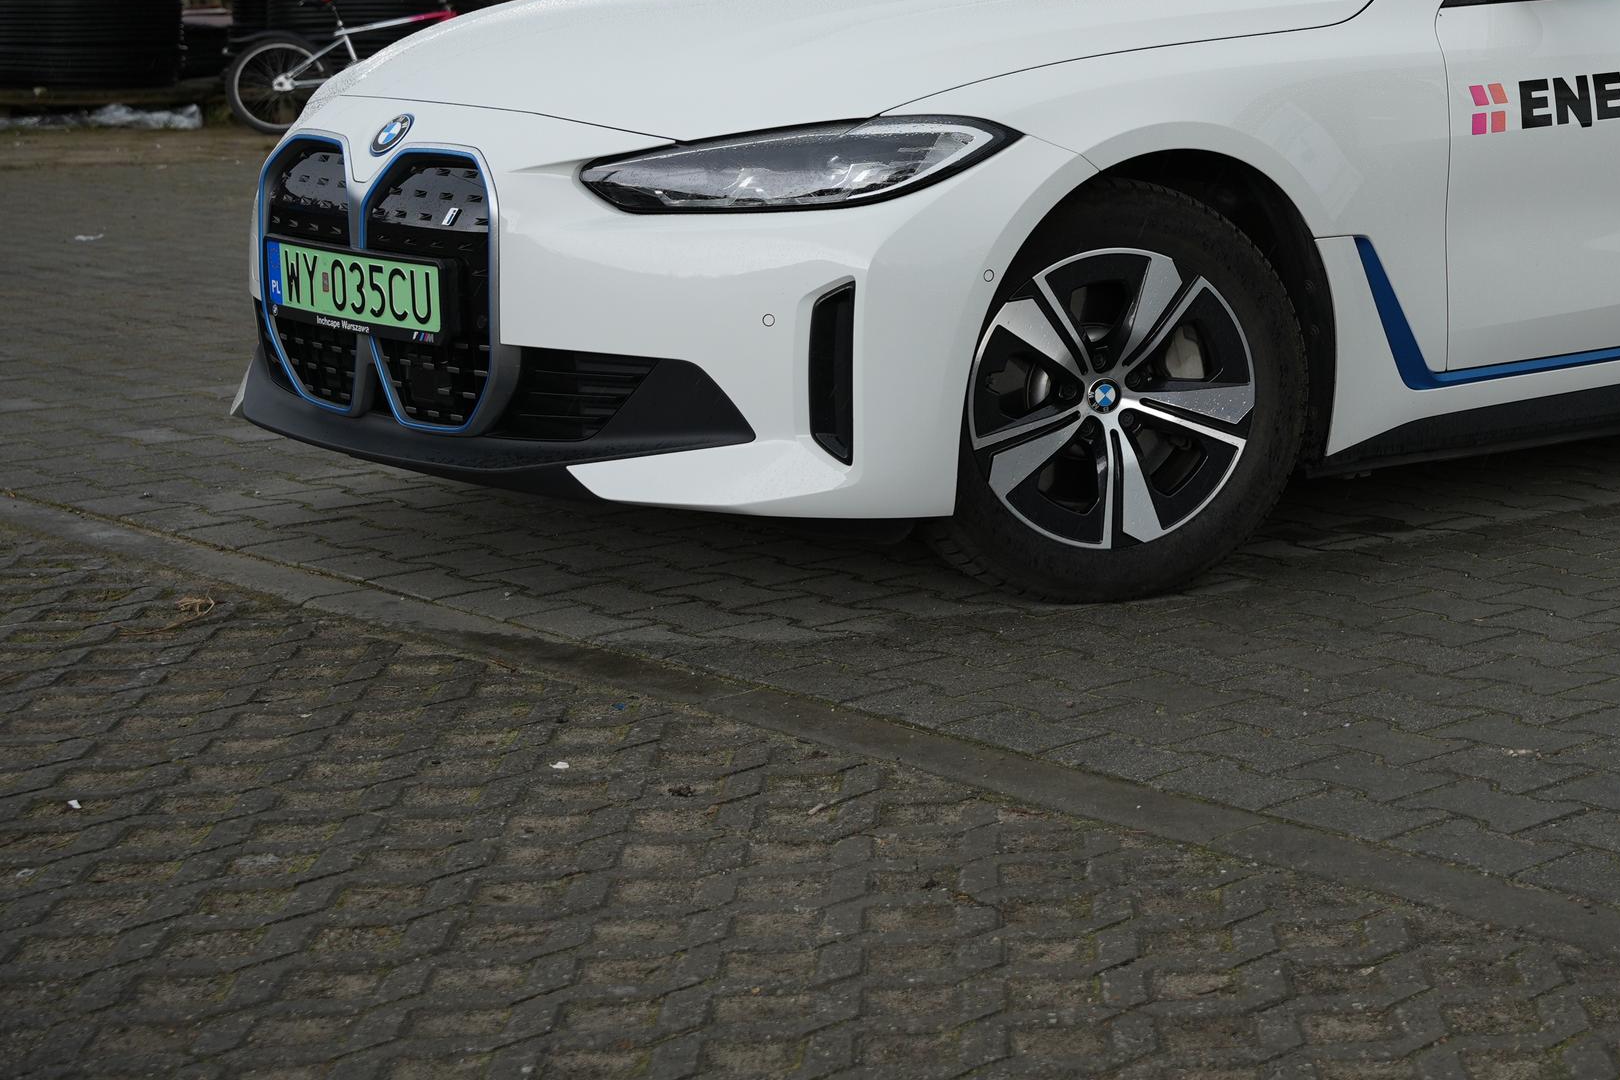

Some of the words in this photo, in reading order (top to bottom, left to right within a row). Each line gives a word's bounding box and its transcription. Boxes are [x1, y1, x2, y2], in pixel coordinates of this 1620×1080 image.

[271, 279, 281, 295] PL
[284, 249, 318, 307] WY
[331, 258, 432, 325] 035CU
[316, 315, 340, 329] Inchcape
